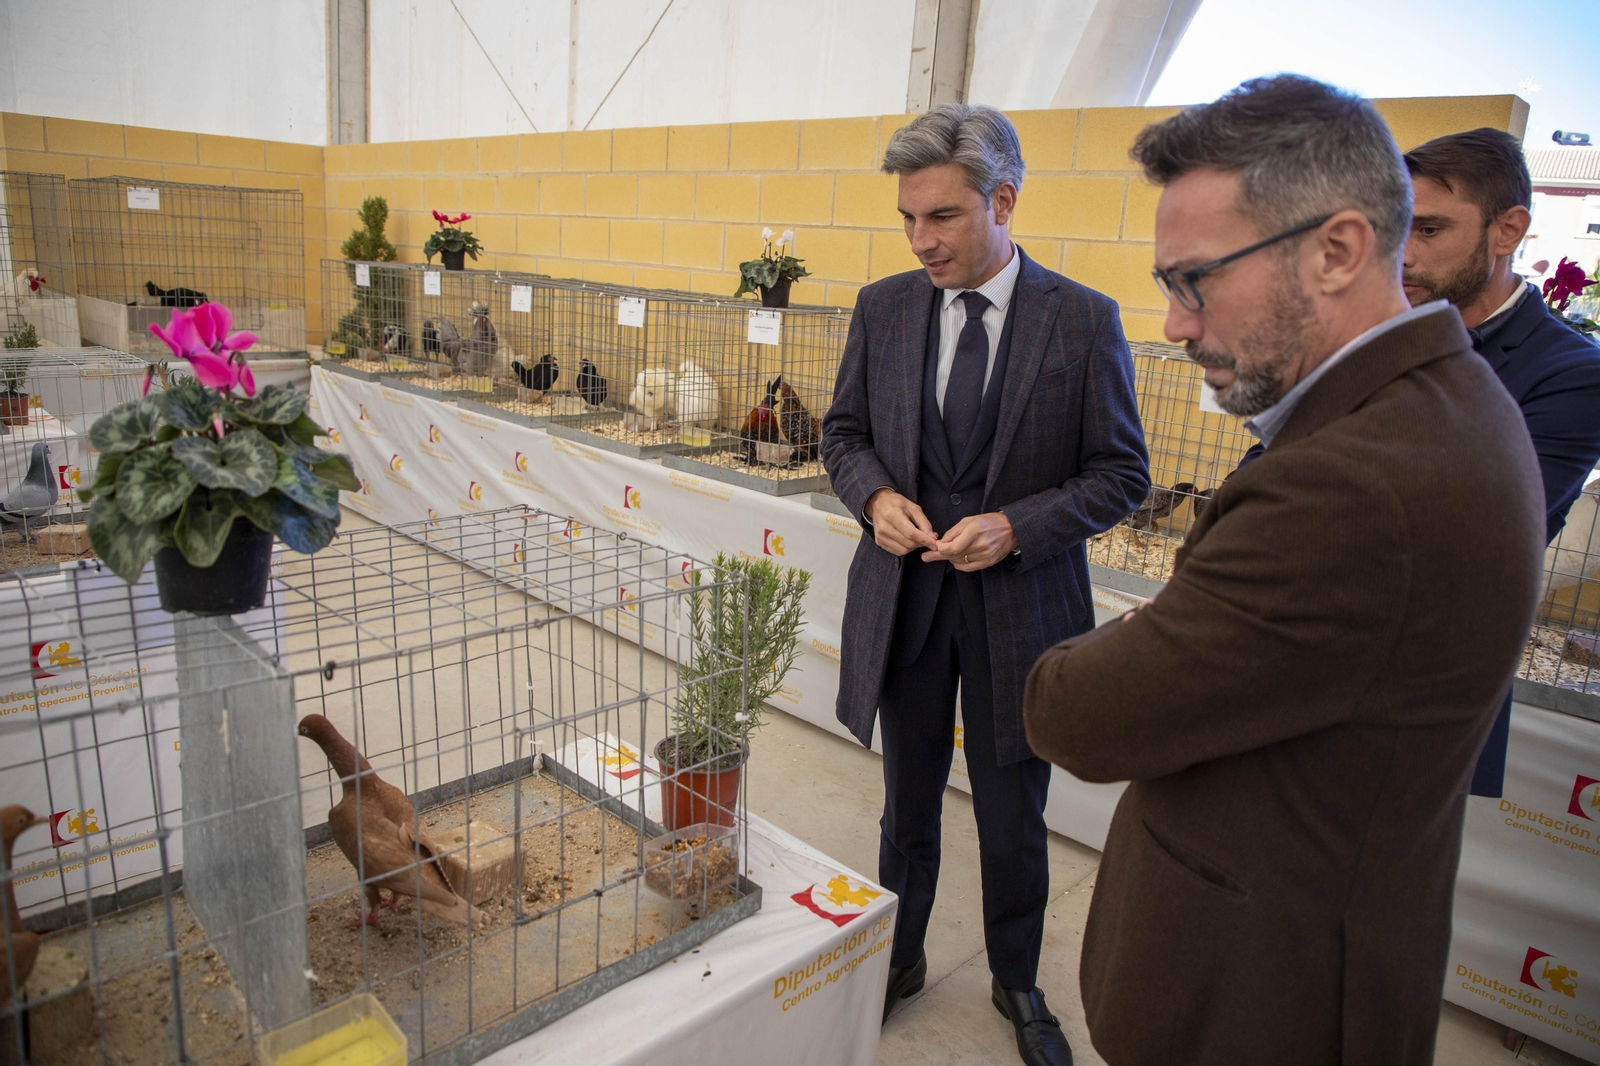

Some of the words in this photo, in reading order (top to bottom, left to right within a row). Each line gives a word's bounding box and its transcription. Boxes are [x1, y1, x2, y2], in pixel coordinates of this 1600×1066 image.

[21, 693, 91, 712] Agopecuario
[93, 681, 141, 697] Provincial
[64, 680, 84, 692] de
[88, 667, 147, 687] Córdoba
[105, 829, 156, 849] Córdob
[1498, 799, 1591, 840] Diputación
[1504, 818, 1542, 836] Centro
[1544, 832, 1600, 857] Agropecu
[773, 929, 868, 999] Diputación
[871, 915, 892, 937] de
[781, 980, 822, 1012] Centro
[1456, 963, 1543, 1009] Diputación
[1547, 1004, 1569, 1020] de
[1461, 981, 1497, 1002] Centro
[1499, 998, 1573, 1034] Agropecuario
